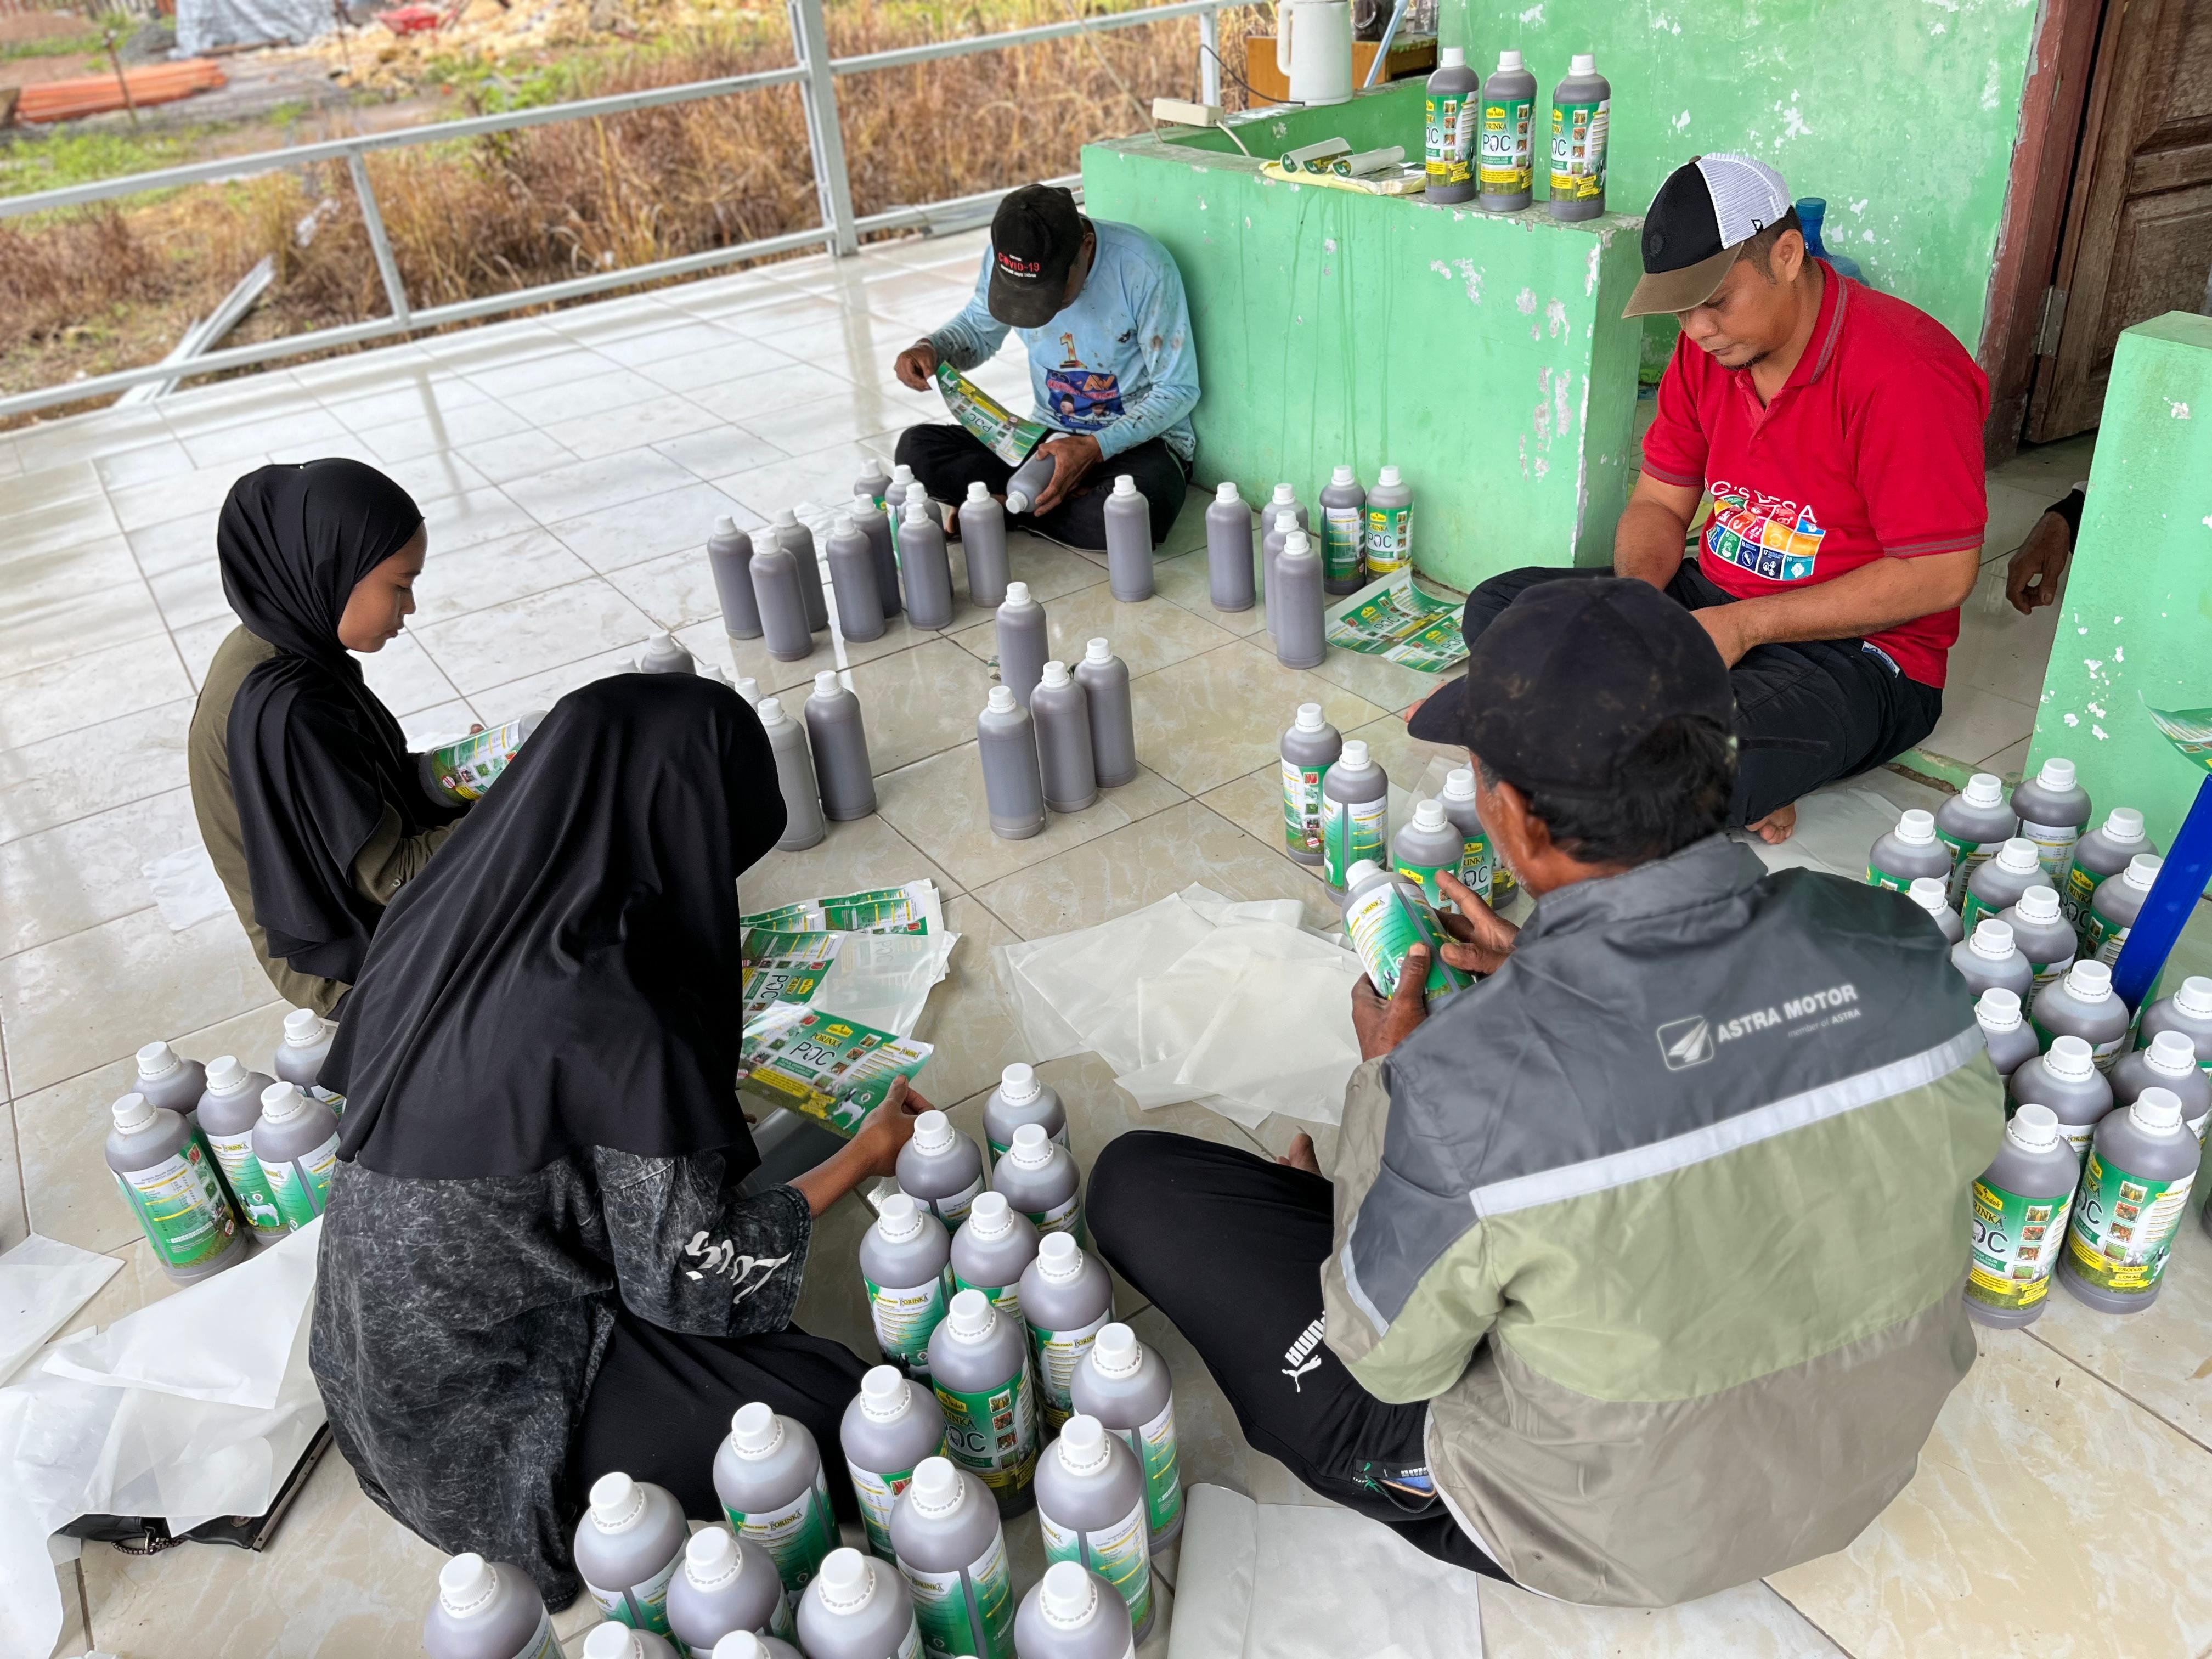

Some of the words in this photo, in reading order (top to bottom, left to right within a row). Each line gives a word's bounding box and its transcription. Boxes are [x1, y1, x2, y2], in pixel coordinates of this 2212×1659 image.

[1426, 127, 1438, 144] OC
[1483, 134, 1511, 152] POC
[1553, 138, 1566, 156] OC
[998, 252, 1041, 272] COVID-19
[1368, 532, 1392, 548] POC
[1374, 616, 1400, 630] POC
[1464, 855, 1485, 866] RINKA
[1464, 865, 1488, 887] OC
[760, 974, 790, 999] POC
[1718, 1007, 1782, 1043] ASTRA
[1783, 984, 1859, 1020] MOTOR
[1787, 1021, 1819, 1039] member
[1820, 1017, 1829, 1028] of
[1832, 1008, 1861, 1025] ASTRA
[808, 1031, 844, 1049] PORINKA
[789, 1041, 836, 1066] POC
[1982, 1192, 2000, 1207] Indah
[2081, 1186, 2102, 1224] OC
[1974, 1201, 2007, 1231] RINKA
[1973, 1218, 2008, 1254] OC
[899, 1293, 928, 1307] PORINKA
[1074, 1333, 1096, 1348] PORIN
[1284, 1310, 1325, 1368] UMA
[950, 1400, 964, 1410] Indah
[943, 1408, 977, 1431] RINKA
[769, 1508, 803, 1531] PORINKA
